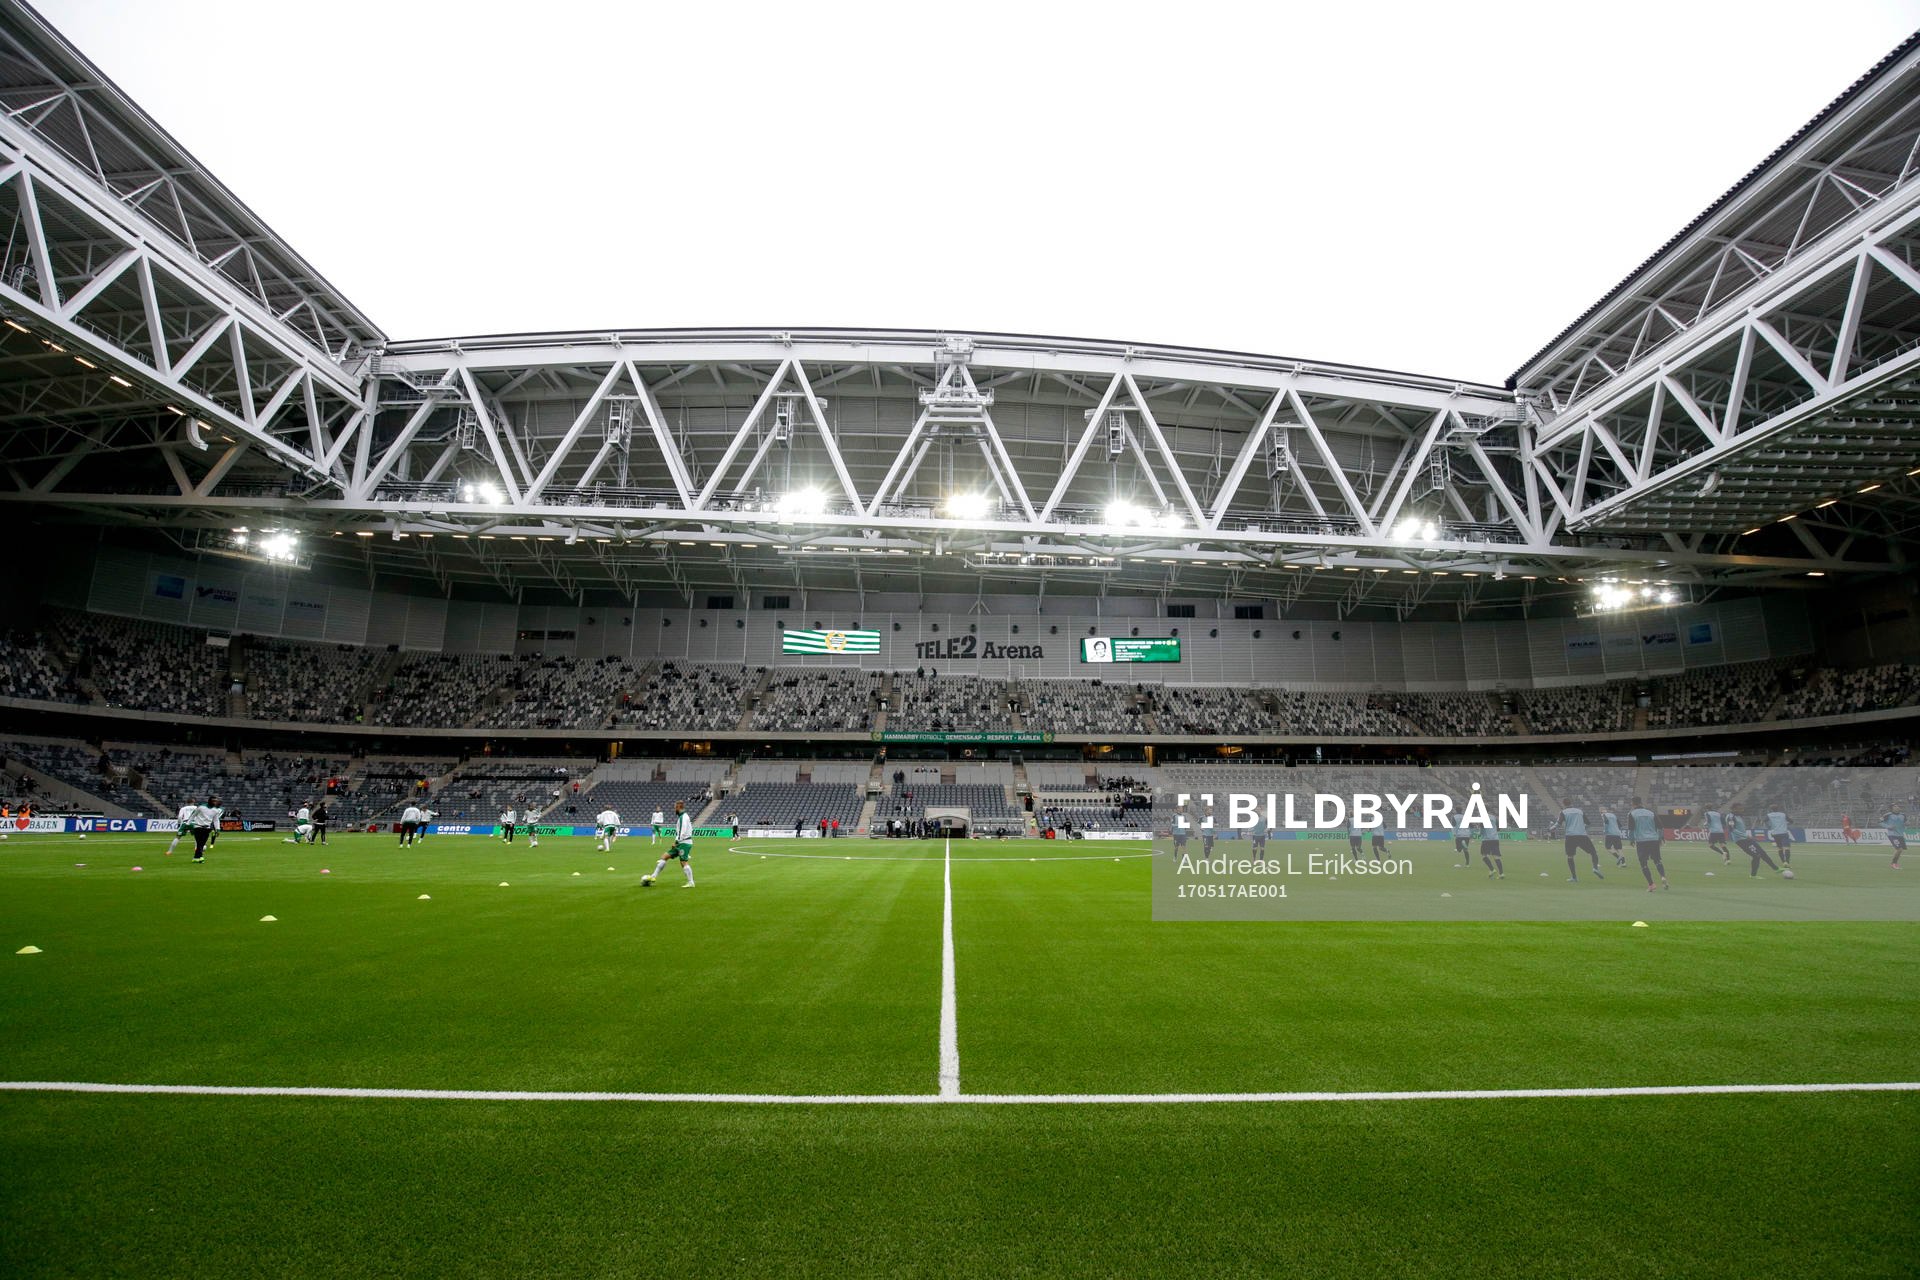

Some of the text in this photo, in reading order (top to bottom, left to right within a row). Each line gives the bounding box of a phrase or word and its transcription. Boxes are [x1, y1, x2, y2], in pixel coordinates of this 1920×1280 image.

[915, 635, 1044, 659] TELE2 Arena
[29, 820, 58, 829] BAJEN
[75, 819, 137, 831] MECA
[1812, 831, 1844, 840] PELIKA
